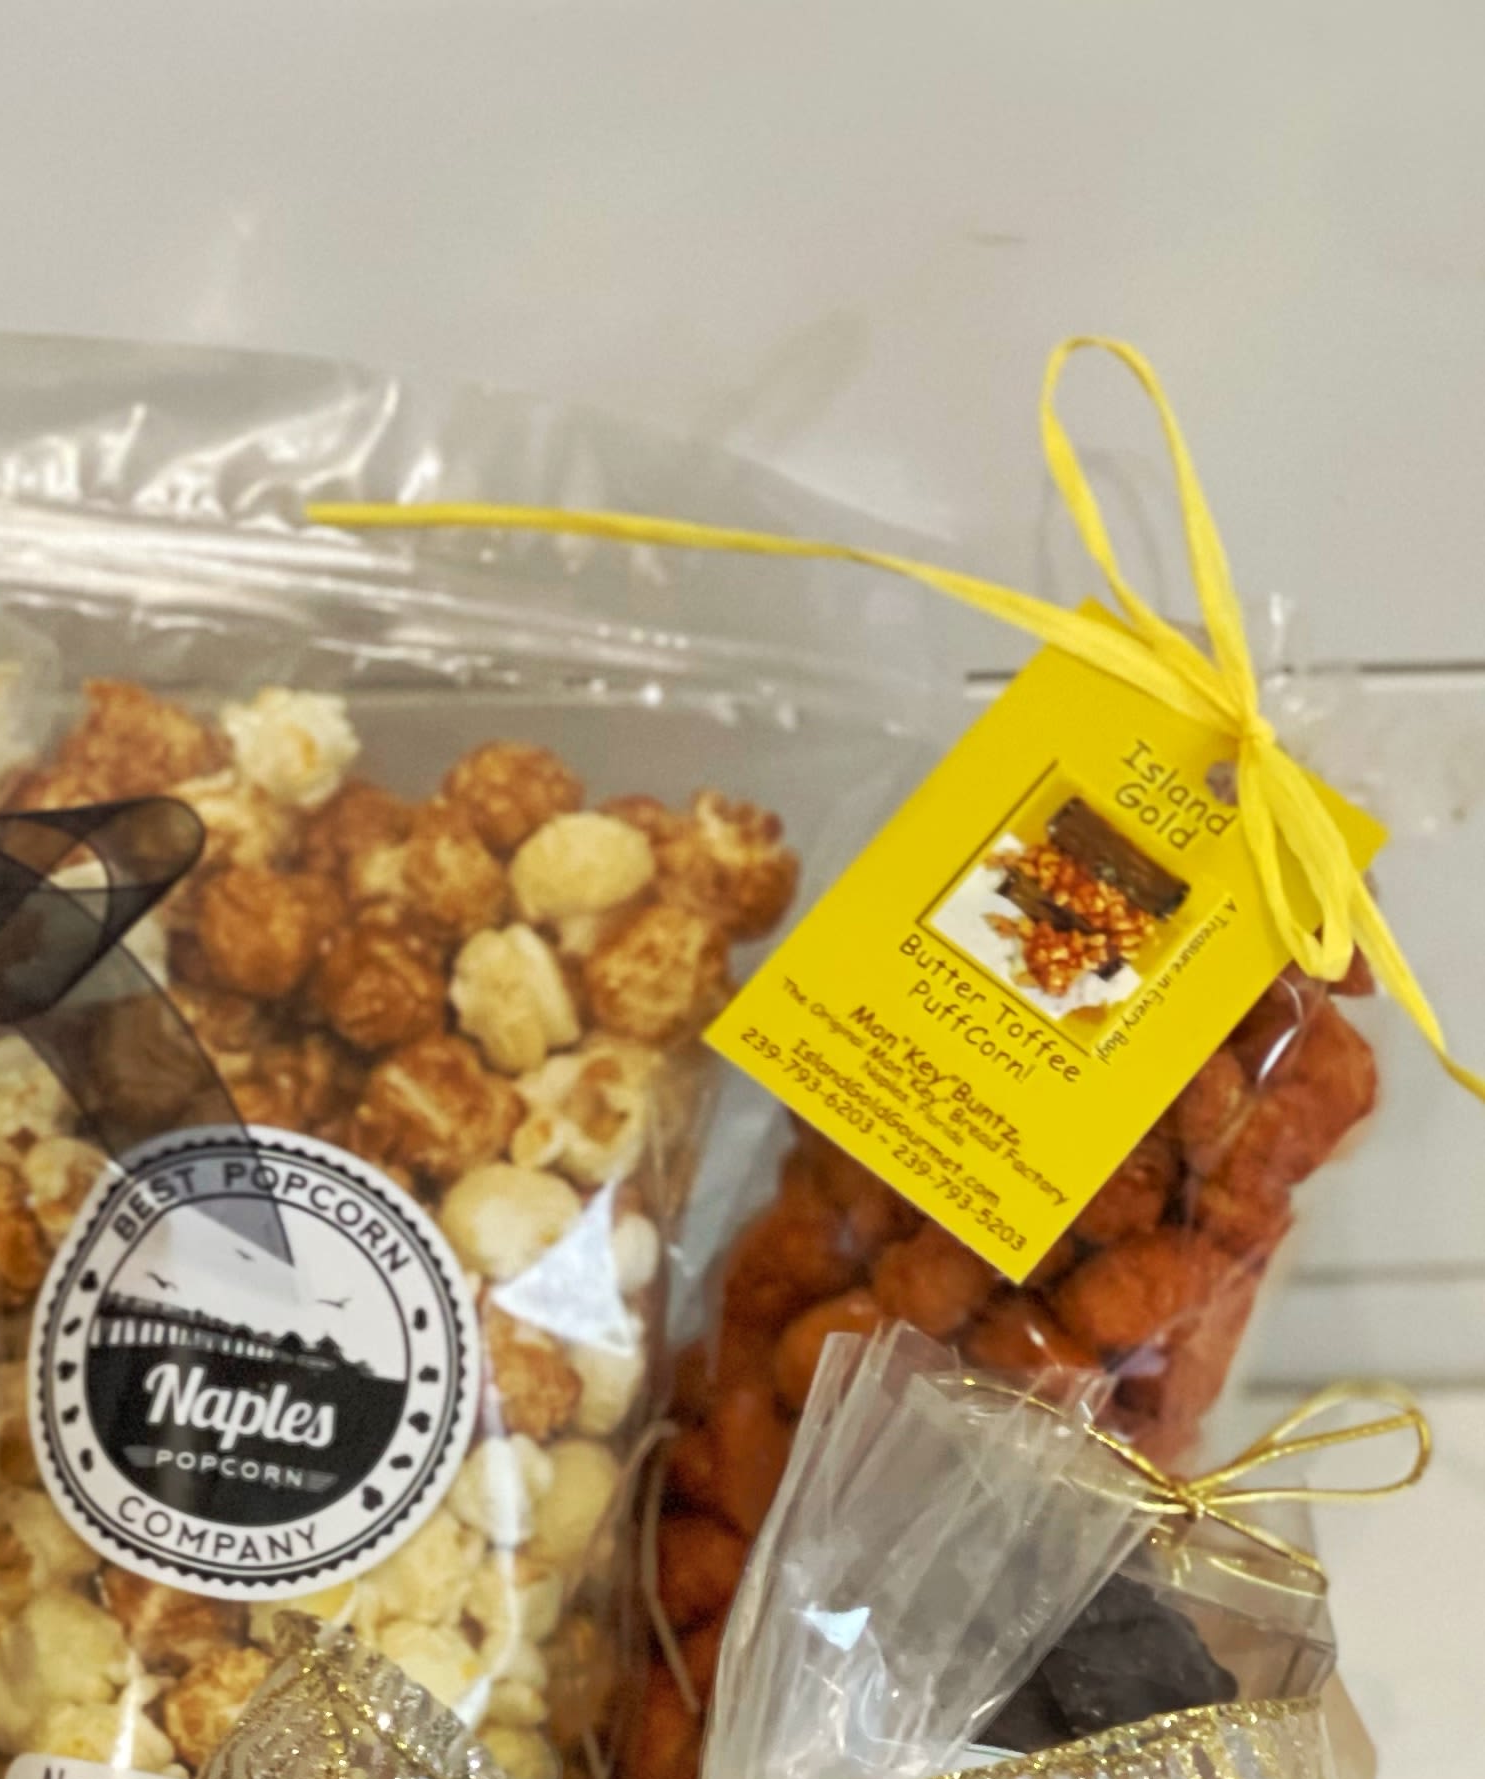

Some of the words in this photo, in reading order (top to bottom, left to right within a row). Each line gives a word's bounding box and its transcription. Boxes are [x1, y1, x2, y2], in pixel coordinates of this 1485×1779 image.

[1114, 781, 1200, 852] Gold
[1120, 738, 1237, 838] Island
[1170, 914, 1229, 973] Treasure
[898, 932, 987, 1003] Butter
[995, 1001, 1081, 1083] Toffee
[908, 978, 1036, 1080] PuffCorn!
[1121, 988, 1165, 1033] Every
[740, 1026, 876, 1134] 239-793-6203
[891, 1143, 1028, 1252] 239-793-5203
[790, 1038, 1002, 1208] IslandGoldGourmet.com
[914, 1100, 965, 1147] Florida
[948, 1106, 1005, 1153] Bread
[1002, 1146, 1070, 1208] Factory
[112, 1167, 196, 1242] BEST
[223, 1162, 411, 1273] POPCORN
[144, 1363, 335, 1450] Naples
[154, 1449, 304, 1488] POPCORN
[118, 1496, 316, 1562] COMPANY
